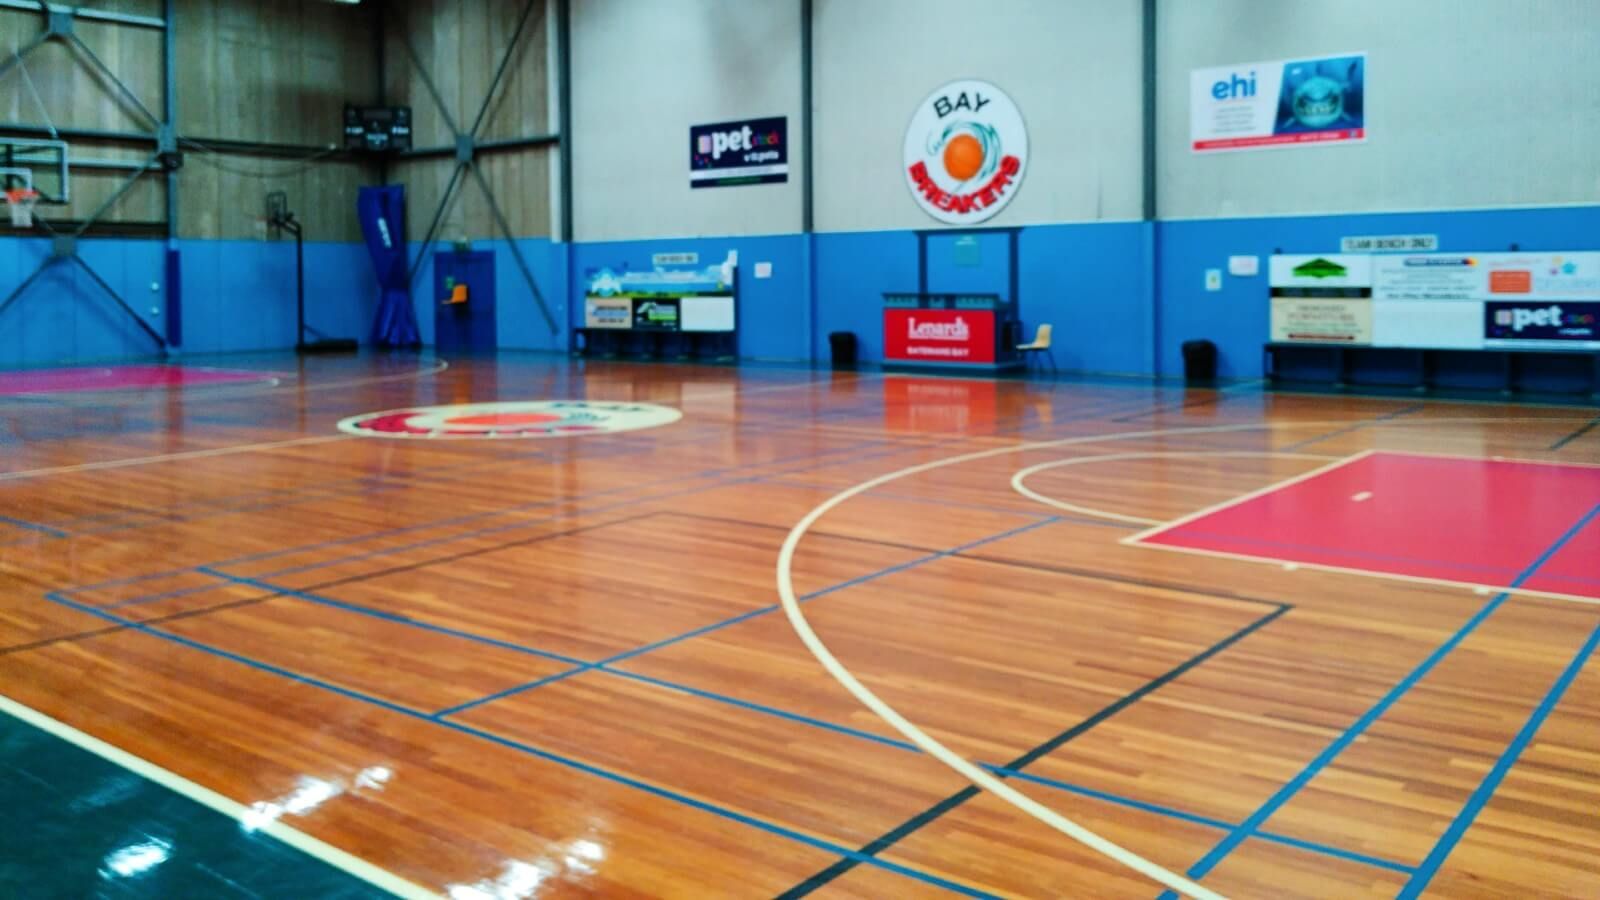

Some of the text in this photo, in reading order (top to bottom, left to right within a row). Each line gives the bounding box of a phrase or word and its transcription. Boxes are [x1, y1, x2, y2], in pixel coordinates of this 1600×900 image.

[1212, 72, 1257, 99] ehi
[933, 91, 990, 118] BAY
[712, 125, 752, 159] pet
[908, 154, 1020, 214] BREAKERS
[1512, 304, 1562, 331] pet
